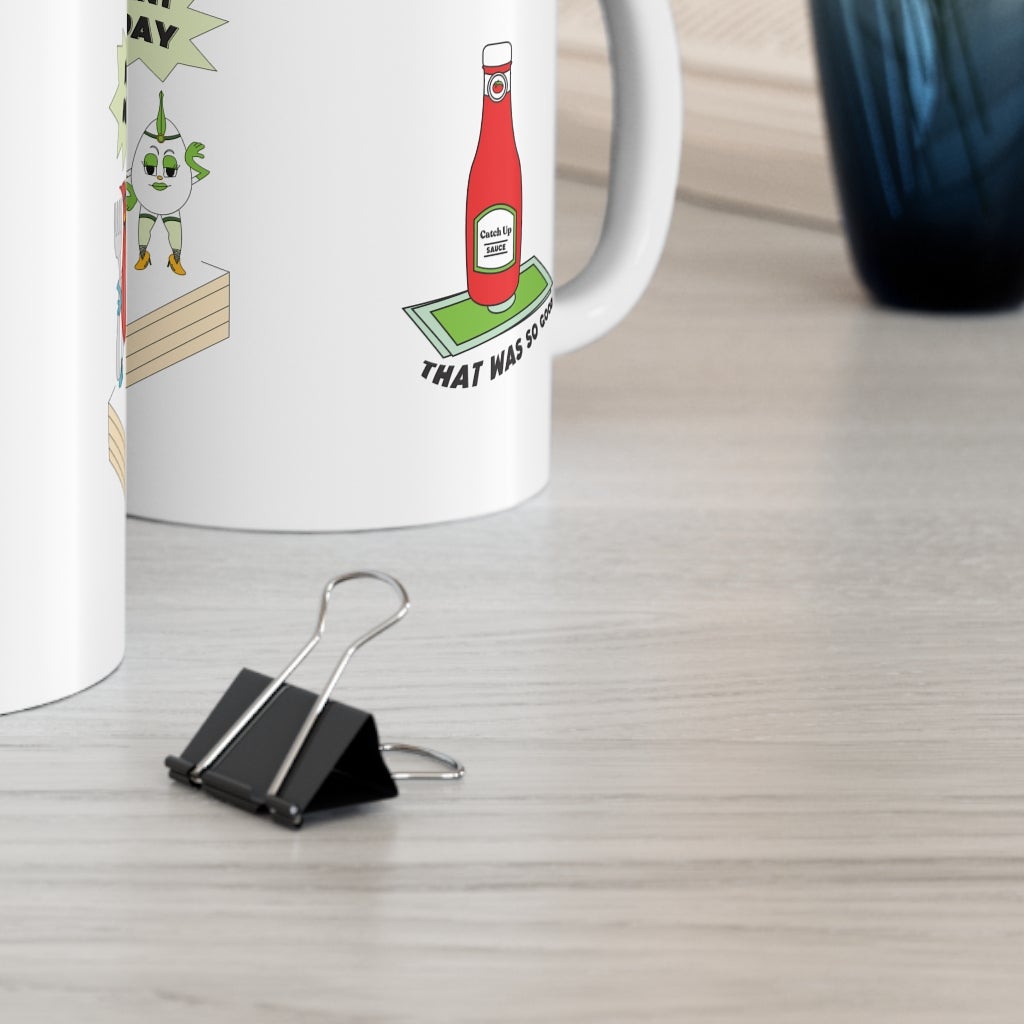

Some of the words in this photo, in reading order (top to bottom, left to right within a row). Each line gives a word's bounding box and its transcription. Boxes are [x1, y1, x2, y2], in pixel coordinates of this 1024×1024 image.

[127, 13, 179, 49] AY
[480, 227, 502, 239] Catch
[502, 225, 512, 236] Up
[486, 243, 506, 254] SAUCE
[421, 360, 484, 389] THAT
[490, 338, 523, 381] WAS
[525, 323, 538, 349] SO
